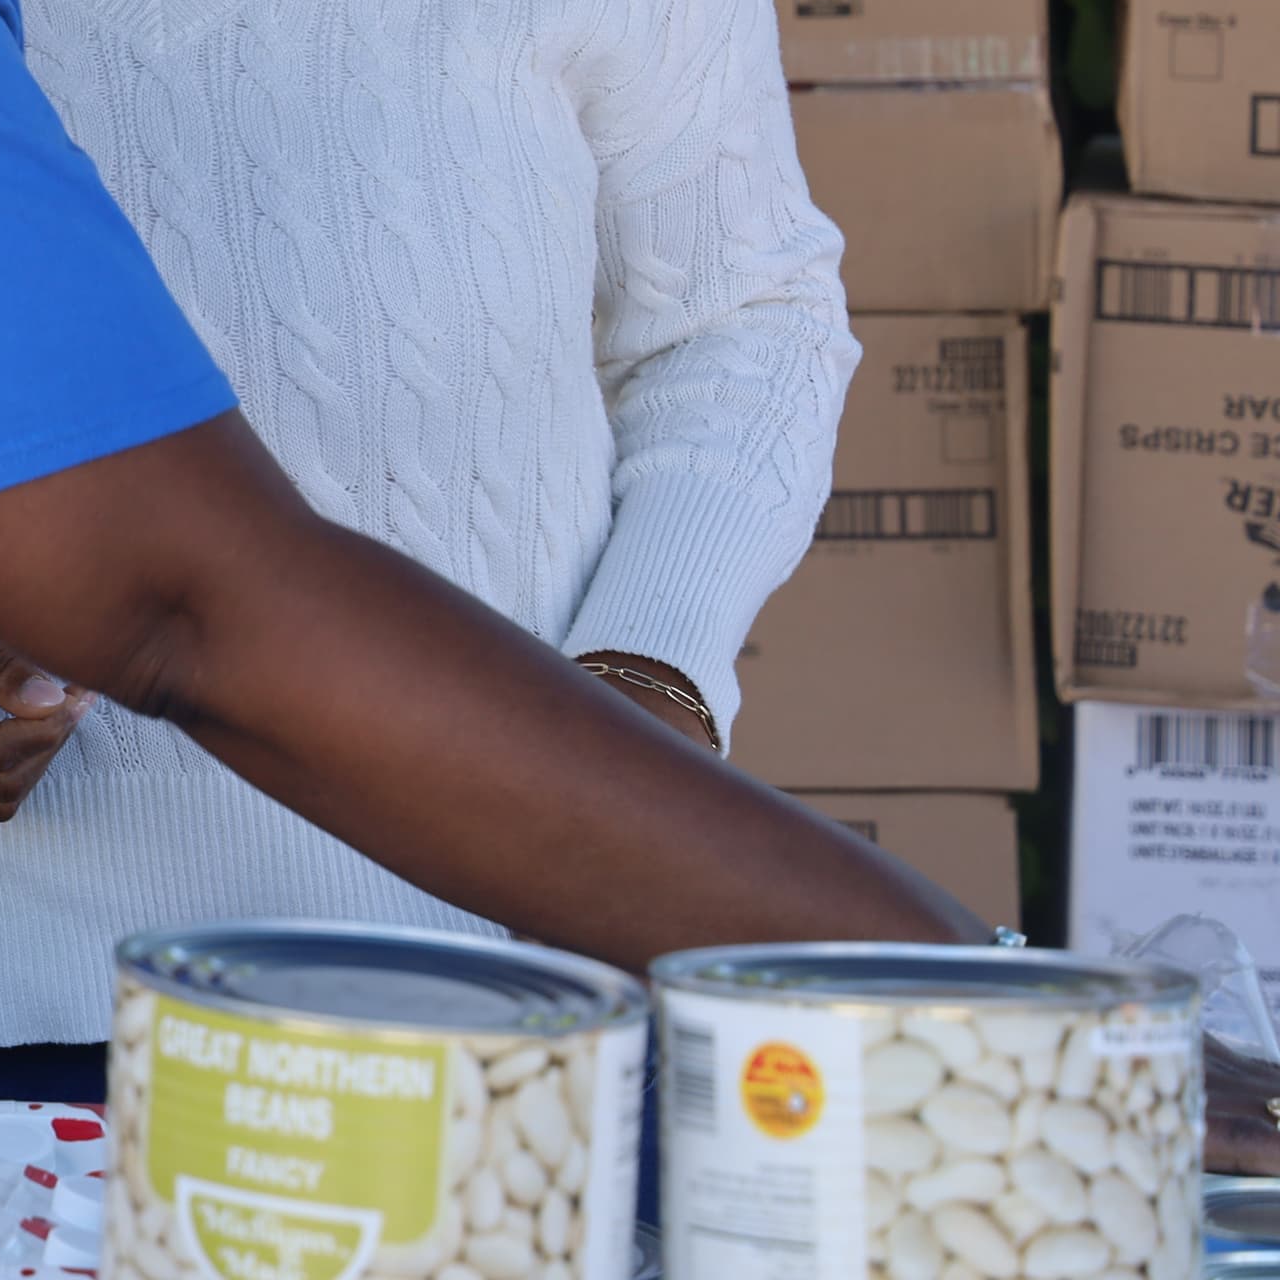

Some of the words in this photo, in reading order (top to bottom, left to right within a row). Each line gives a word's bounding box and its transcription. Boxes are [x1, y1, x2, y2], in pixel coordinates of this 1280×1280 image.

[1119, 424, 1240, 457] CRISPS
[1225, 476, 1280, 519] ER
[161, 1017, 242, 1072] GREAT
[248, 1040, 433, 1100] NORTHERN
[226, 1084, 332, 1140] BEANS
[227, 1148, 324, 1190] FANCY
